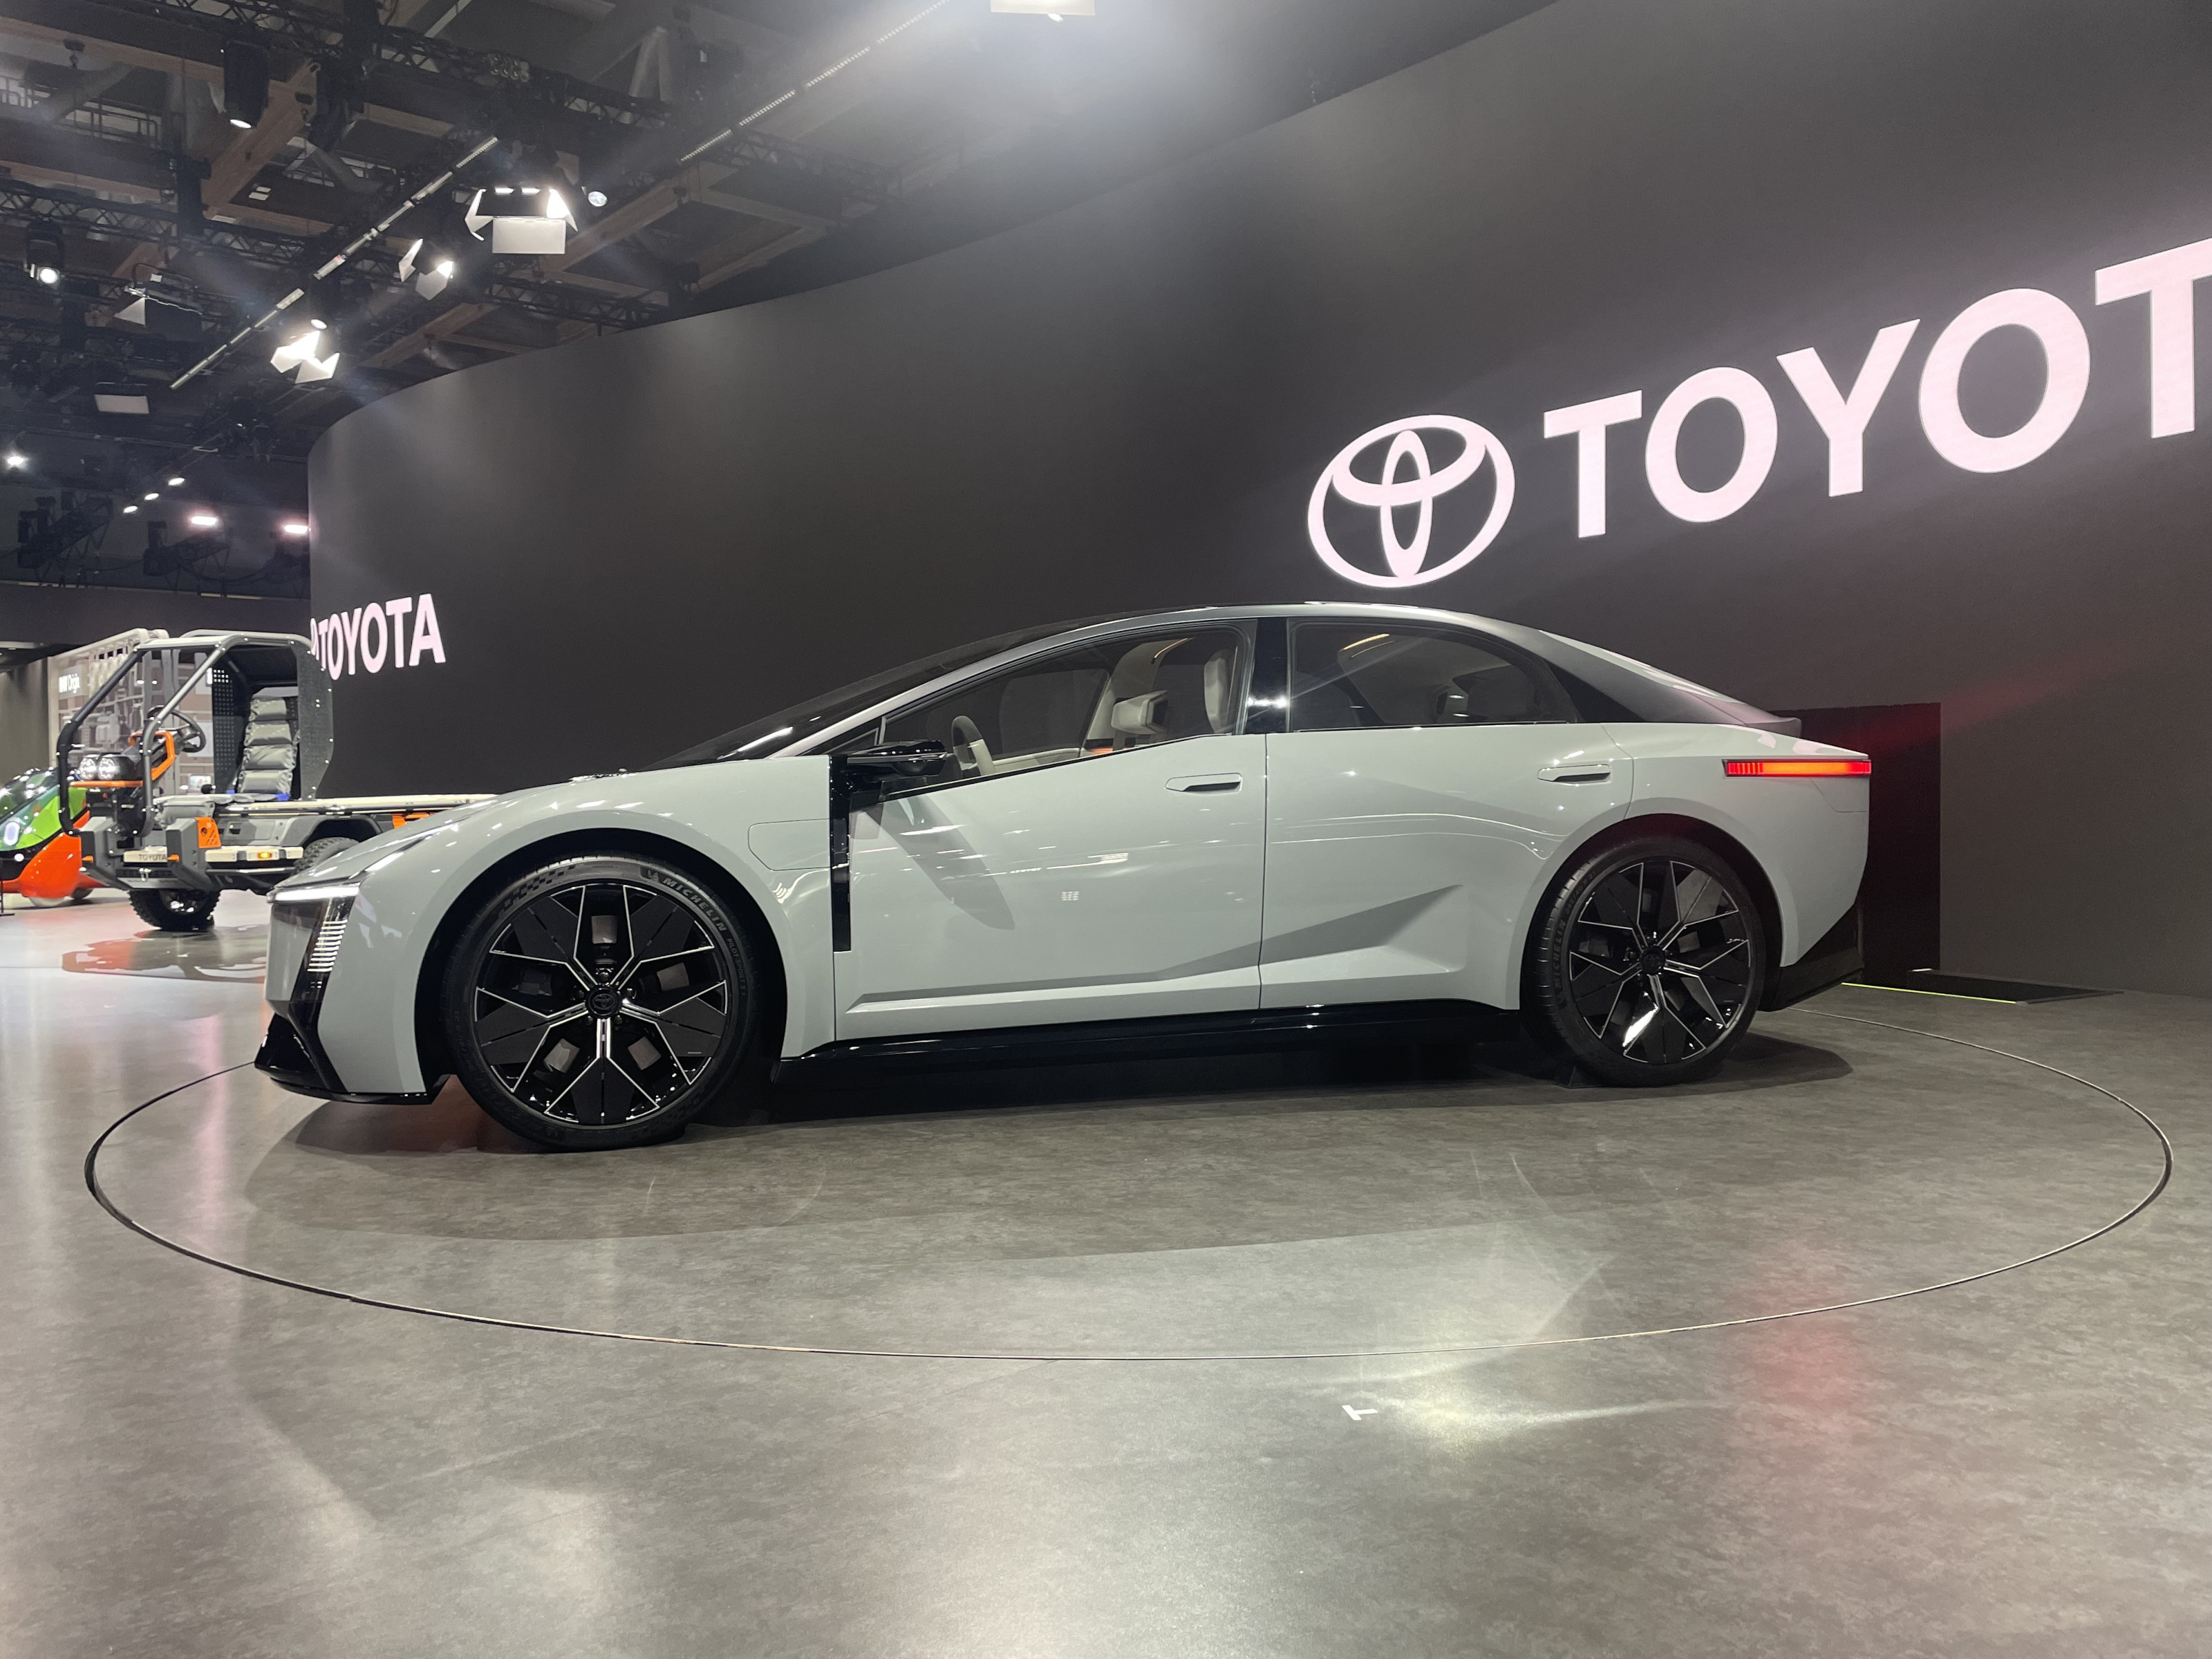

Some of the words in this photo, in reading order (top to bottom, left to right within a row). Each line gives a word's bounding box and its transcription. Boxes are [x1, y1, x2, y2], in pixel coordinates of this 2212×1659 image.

[318, 593, 446, 680] TOYOTA
[663, 877, 728, 932] MICHELIN
[727, 937, 739, 957] PILOT
[735, 959, 746, 982] SPORT
[1553, 919, 1567, 990] MICHELIN
